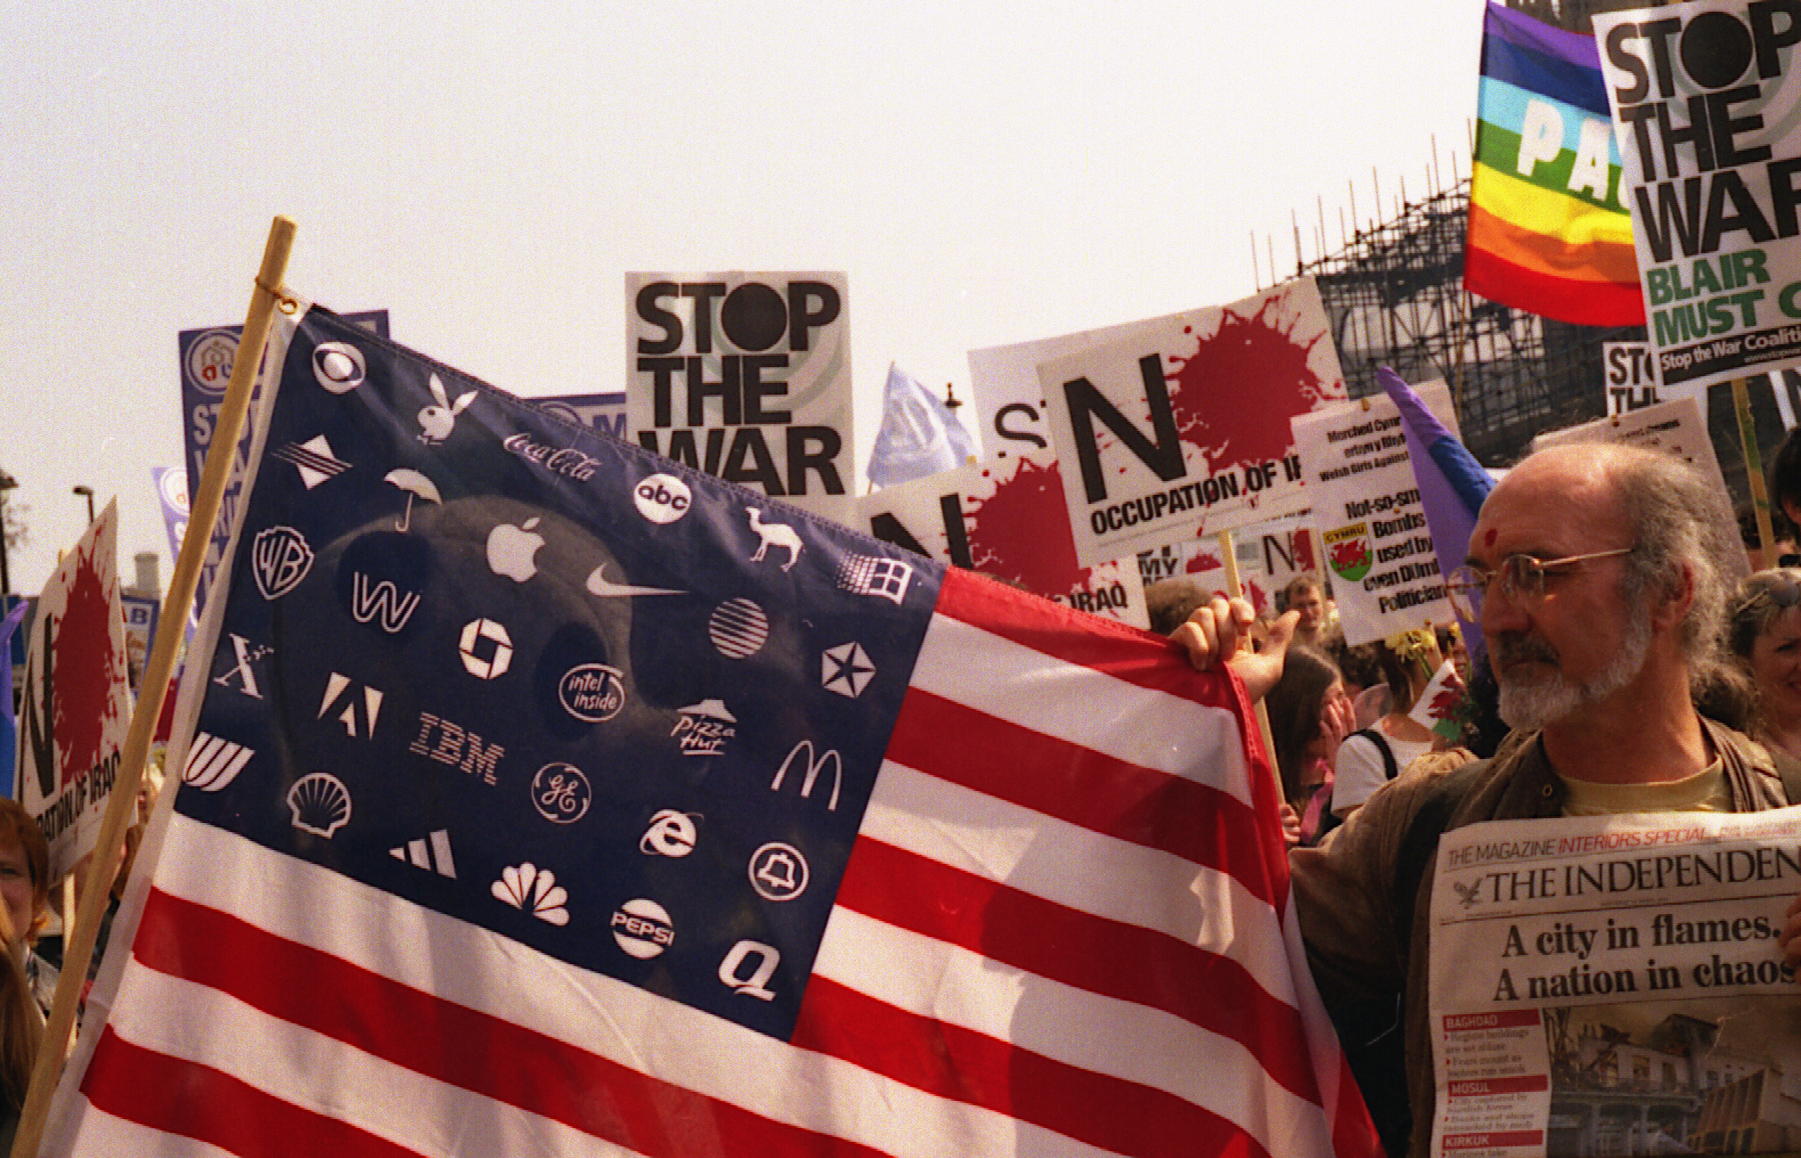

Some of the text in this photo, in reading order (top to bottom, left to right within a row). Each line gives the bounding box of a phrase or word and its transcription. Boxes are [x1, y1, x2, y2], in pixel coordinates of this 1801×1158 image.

[1619, 84, 1772, 184] THE
[1647, 248, 1771, 306] BLAIR
[635, 281, 841, 354] STOP
[1652, 289, 1764, 347] MUST
[1661, 352, 1692, 370] Stop
[1694, 346, 1712, 362] the
[1713, 340, 1741, 357] War
[637, 354, 792, 427] THE
[638, 484, 689, 510] abc
[1091, 472, 1239, 534] OCCUPATION
[1246, 462, 1277, 492] OF
[1372, 512, 1426, 539] Bombs
[1376, 538, 1415, 564] used
[1138, 558, 1178, 576] MY
[1363, 571, 1399, 592] even
[1070, 585, 1128, 612] IRAQ
[569, 672, 604, 692] intel
[574, 692, 617, 710] inside
[670, 714, 736, 738] Pizza
[409, 712, 504, 785] IBM
[680, 735, 725, 751] Hut
[1449, 845, 1473, 865] THE
[1476, 839, 1556, 861] MAGAZINE
[1558, 831, 1641, 853] INTERIORS
[1644, 827, 1708, 846] SPECIAL
[1487, 867, 1556, 902] THE
[610, 910, 675, 947] PEPSI
[1503, 913, 1781, 960] A city in flames.
[1494, 954, 1796, 1001] A nation in chaos
[1447, 1014, 1498, 1029] BAGHDAD
[1452, 1081, 1490, 1095] MOSUL
[1446, 1134, 1489, 1147] KIRKUK
